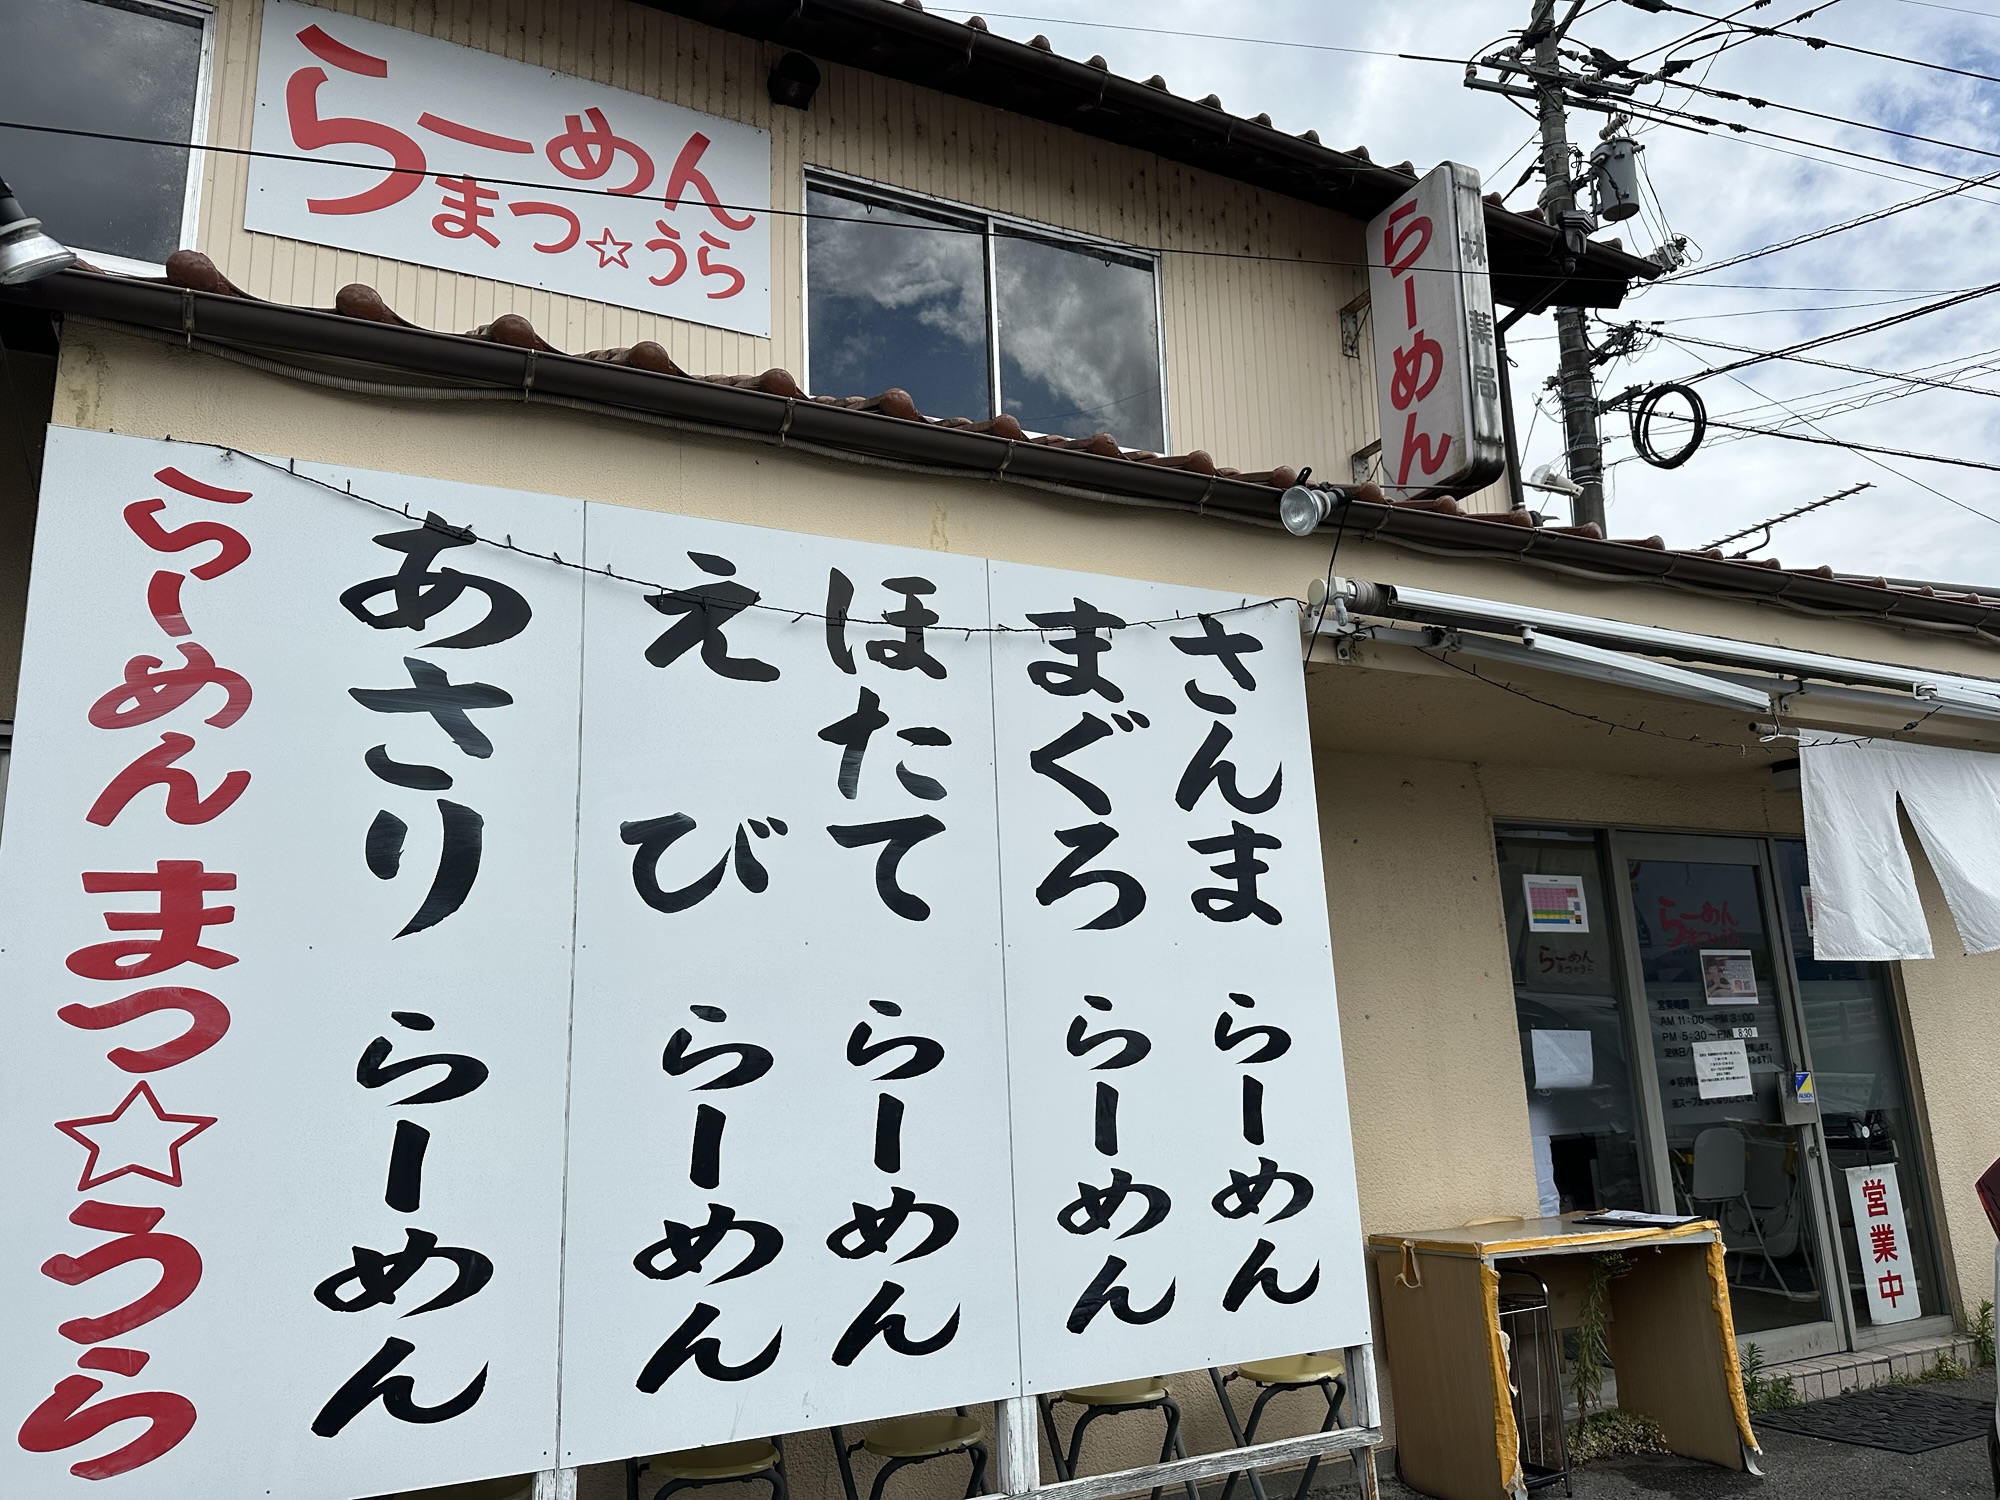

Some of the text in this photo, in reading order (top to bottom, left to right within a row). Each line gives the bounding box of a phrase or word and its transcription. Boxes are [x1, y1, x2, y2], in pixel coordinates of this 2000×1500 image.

[286, 23, 756, 231] らーめん
[1383, 198, 1452, 491] らーめん
[86, 466, 253, 827] らーめん
[310, 510, 533, 1438] あさり らーめん
[619, 550, 789, 1395] えび らーめん
[817, 566, 961, 1368] ほたて らーめん
[1025, 596, 1177, 1335] まぐろ らーめん
[1169, 612, 1321, 1313] さんま らーめん
[1539, 944, 1595, 974] らーめん
[1658, 895, 1740, 949] らーめん
[1660, 1016, 1675, 1027] AM
[1662, 1032, 1678, 1042] PM
[1737, 1027, 1753, 1038] 8:30
[1861, 1178, 1905, 1309] 営業中
